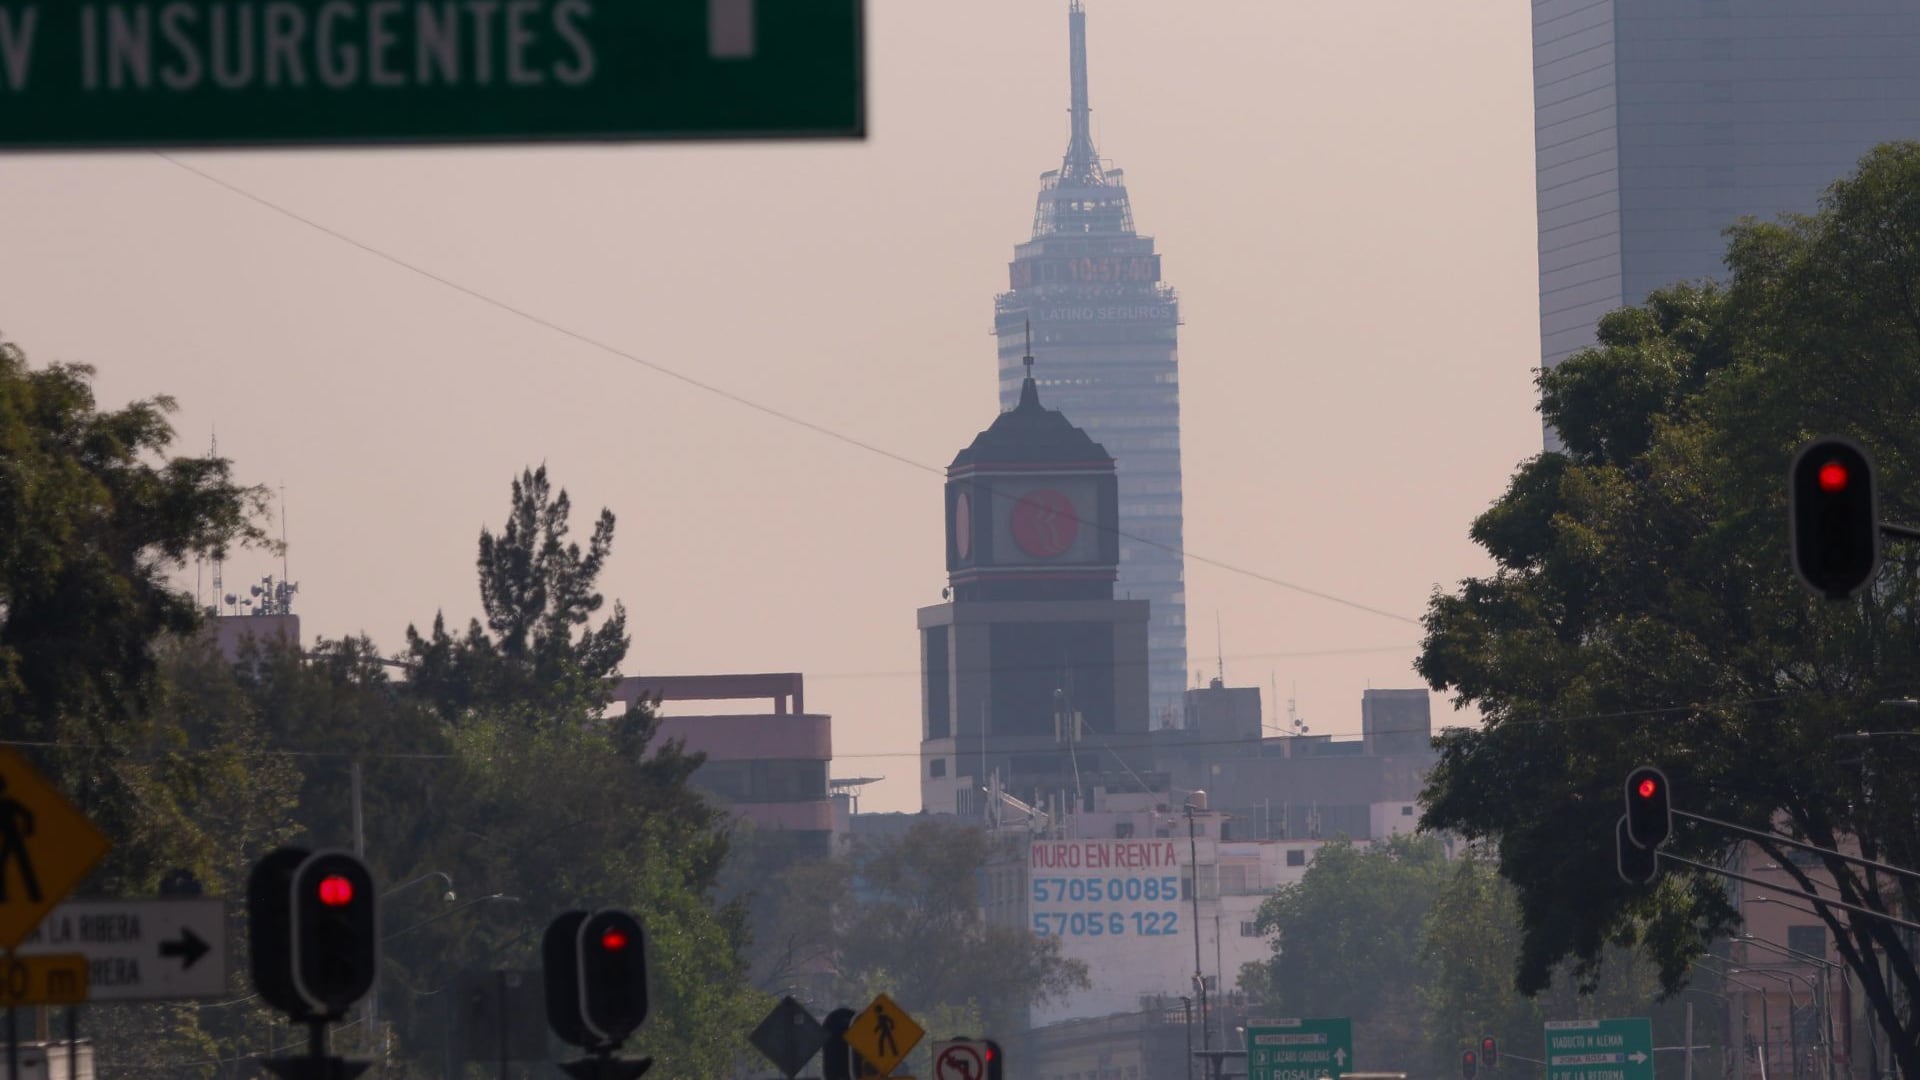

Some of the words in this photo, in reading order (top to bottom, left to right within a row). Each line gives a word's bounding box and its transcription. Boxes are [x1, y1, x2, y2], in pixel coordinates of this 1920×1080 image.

[81, 0, 596, 90] INSURGENTES
[1040, 307, 1093, 320] LATINO
[1098, 306, 1170, 319] SEGUROS
[1032, 844, 1080, 868] MURO
[1085, 844, 1110, 868] EN
[1115, 842, 1176, 867] RENTA
[79, 914, 141, 943] RIBERA
